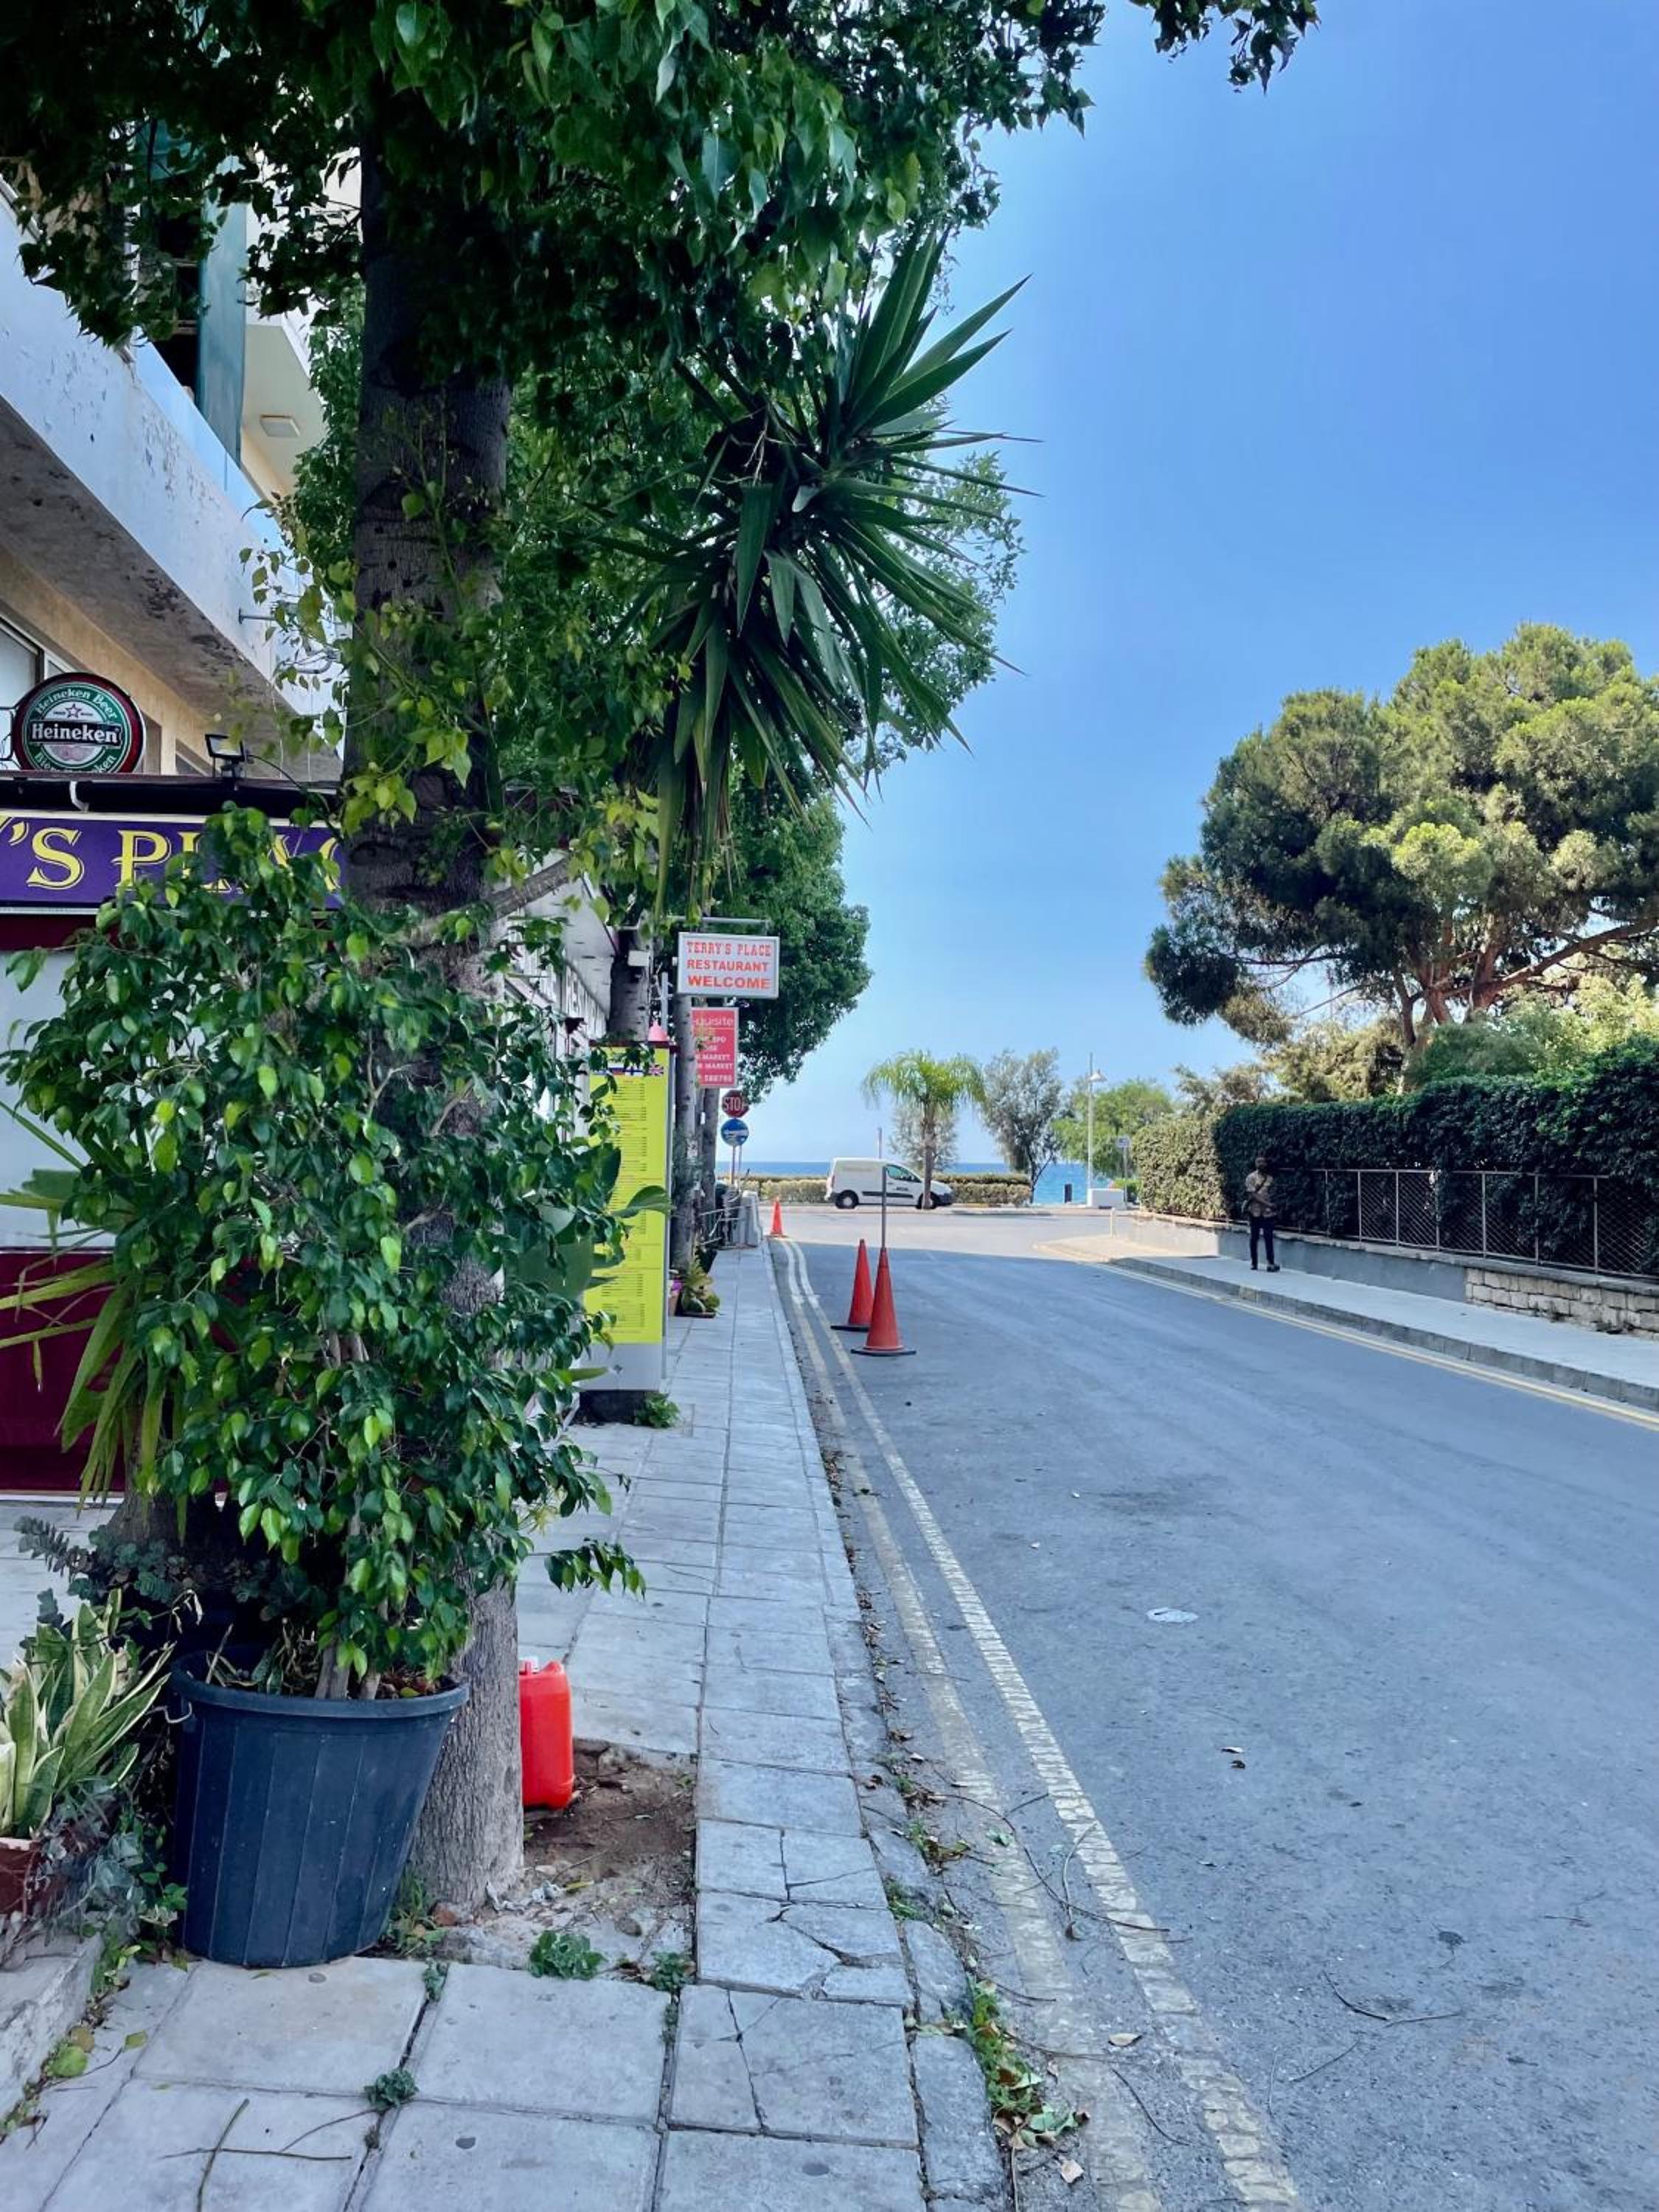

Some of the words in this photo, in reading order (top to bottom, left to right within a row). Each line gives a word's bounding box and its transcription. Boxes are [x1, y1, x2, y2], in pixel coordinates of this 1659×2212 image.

[36, 689, 91, 714] Heineken
[94, 694, 118, 719] Beer
[31, 723, 118, 743] Heineken
[0, 815, 84, 890] 'S
[686, 942, 732, 955] TERRY'S
[738, 944, 771, 956] PLACE
[686, 959, 769, 972] RESTAURANT
[687, 975, 772, 990] WELCOME
